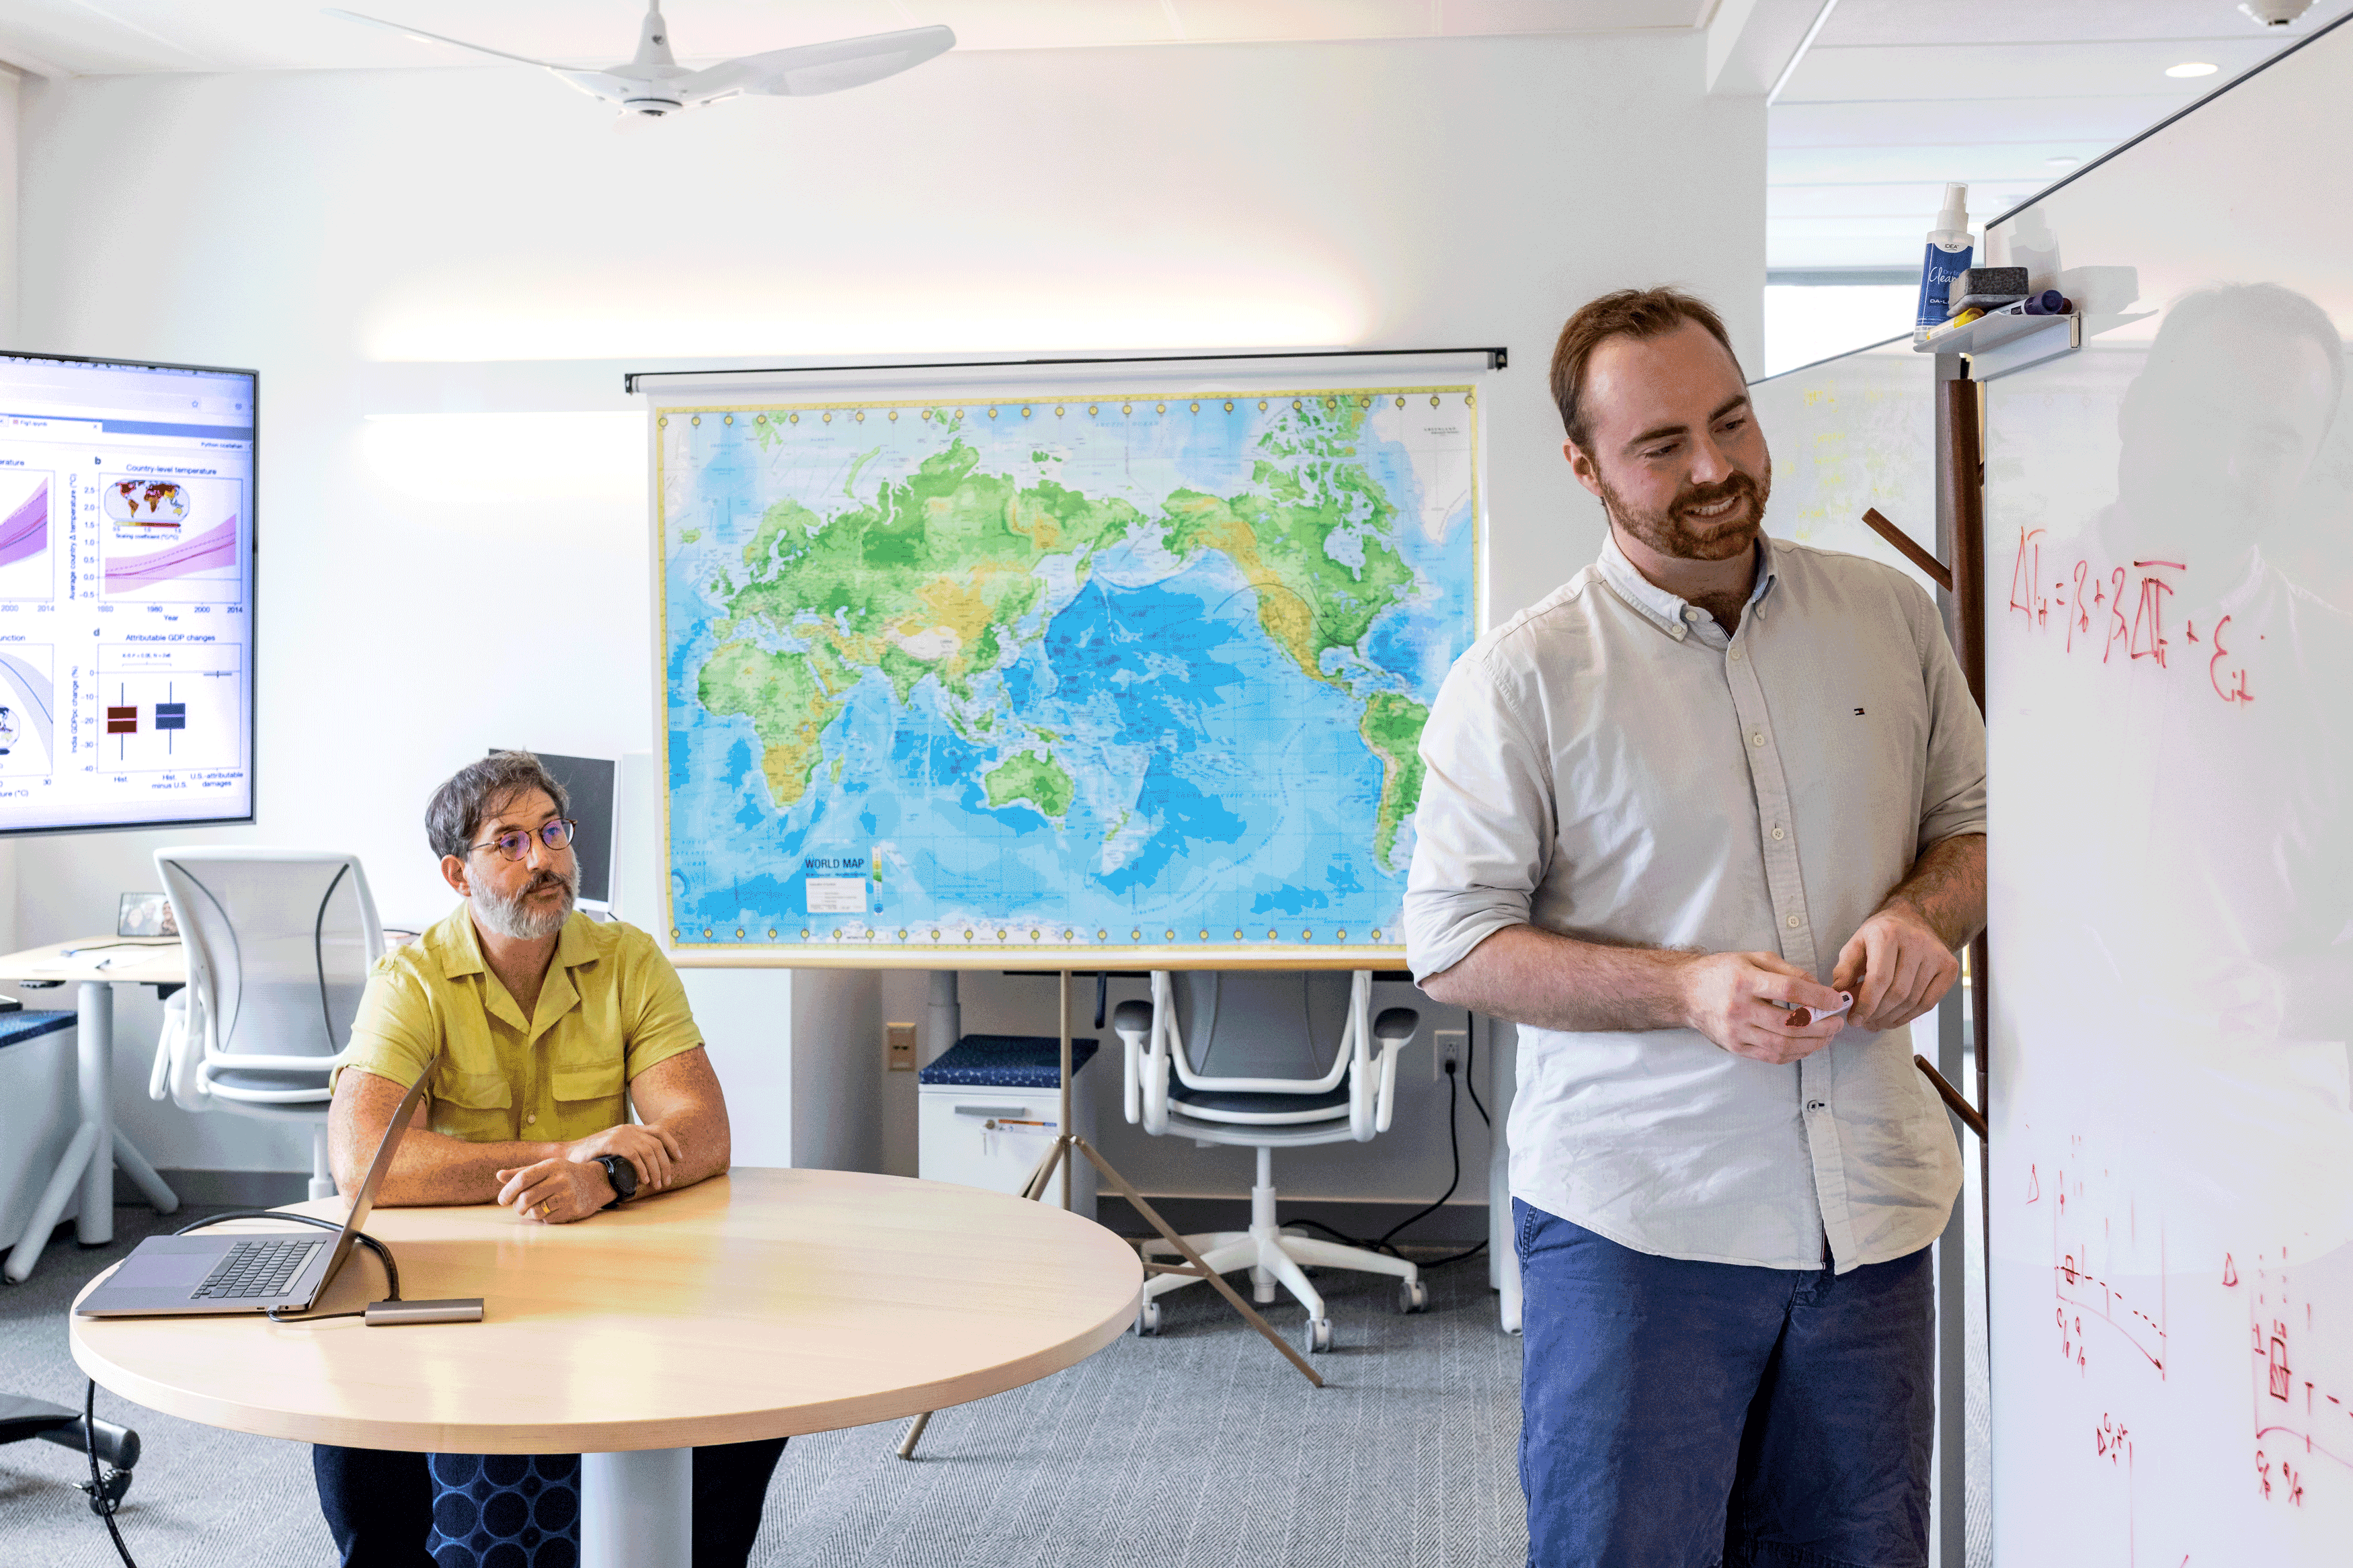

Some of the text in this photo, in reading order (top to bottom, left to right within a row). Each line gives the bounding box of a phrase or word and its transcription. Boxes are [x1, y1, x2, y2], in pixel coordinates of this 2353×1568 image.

[95, 456, 101, 464] b
[175, 465, 216, 475] temperature
[227, 606, 243, 614] 2014
[163, 614, 180, 622] Year
[93, 627, 100, 637] d
[186, 634, 216, 643] changes
[202, 780, 232, 789] damages
[805, 858, 865, 869] WORLD MAP
